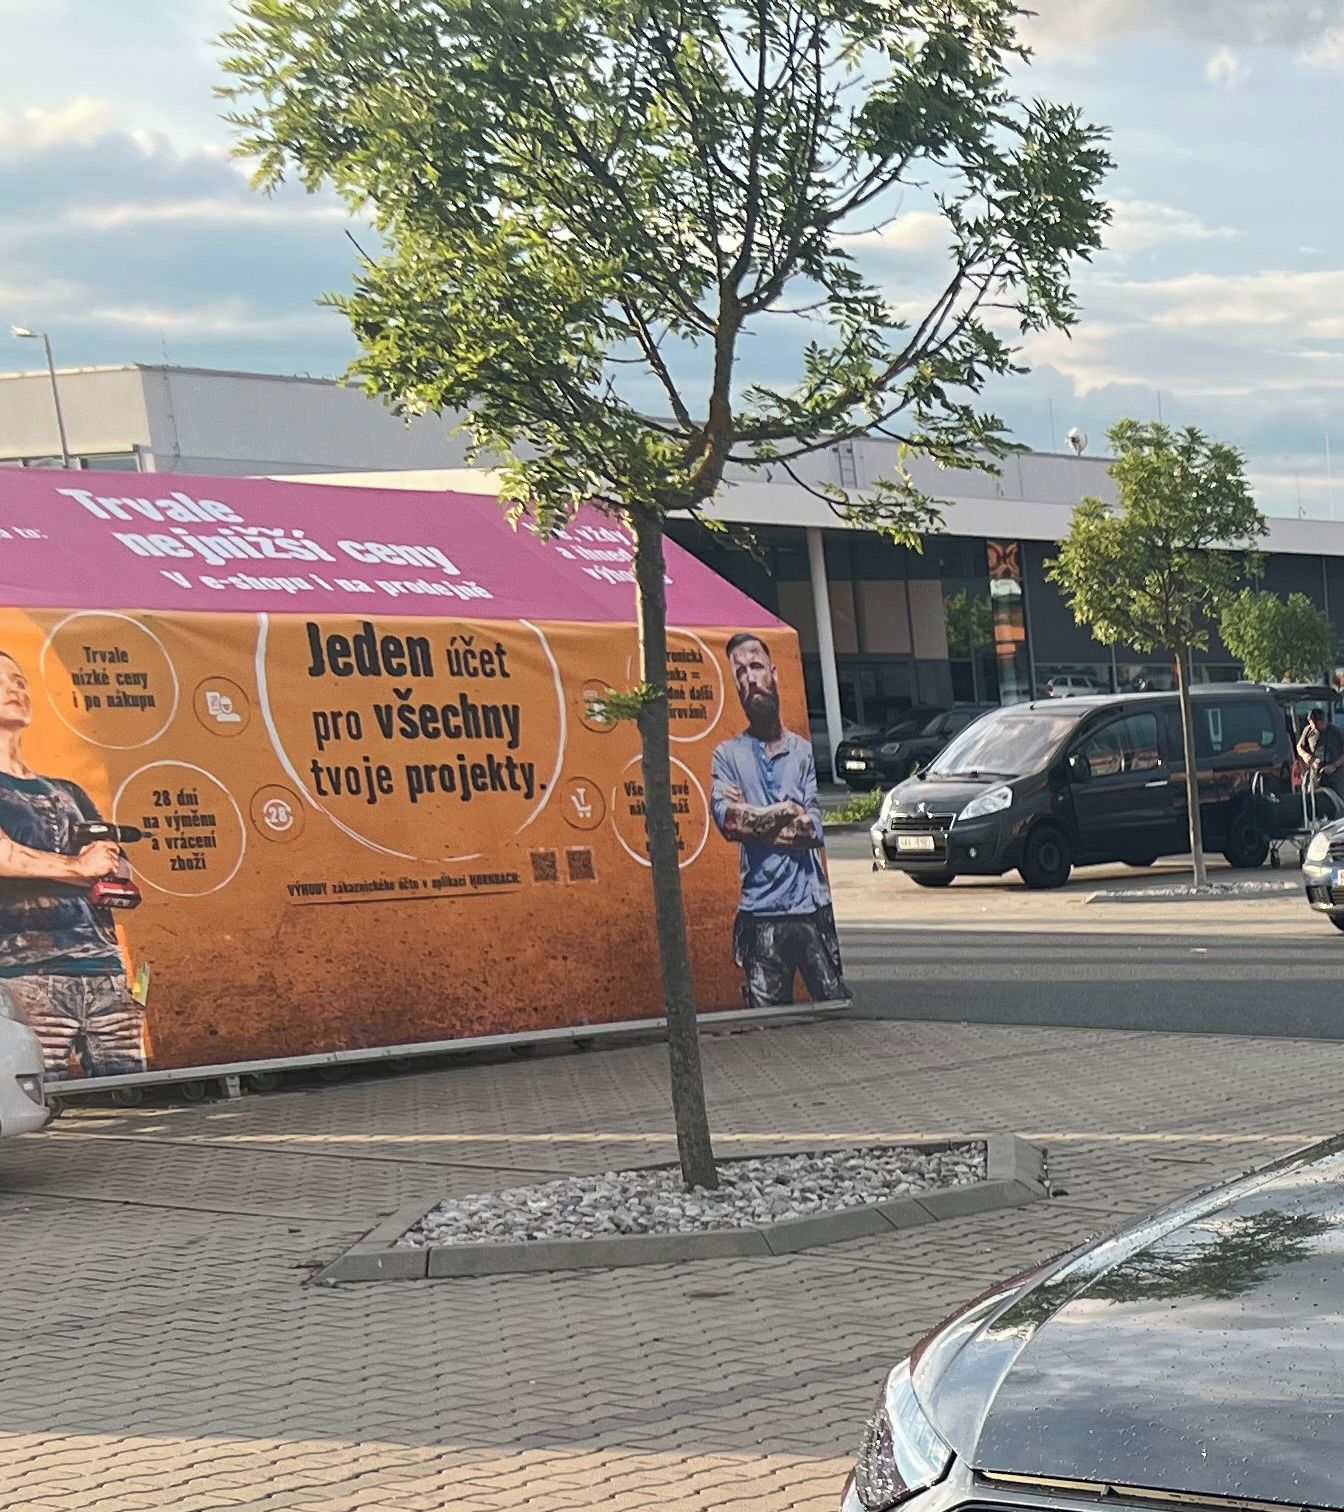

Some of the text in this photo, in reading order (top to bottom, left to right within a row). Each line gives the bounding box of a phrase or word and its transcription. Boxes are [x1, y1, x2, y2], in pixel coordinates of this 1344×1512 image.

[55, 487, 244, 523] Trvale
[112, 526, 461, 576] nejnižší ceny
[334, 578, 375, 593] na
[82, 646, 129, 664] Trvale
[306, 621, 511, 678] Jeden účet
[115, 671, 148, 690] ceny
[84, 694, 102, 712] po
[312, 687, 520, 751] pro všechny
[310, 753, 548, 805] tvoje projekty.
[152, 789, 172, 807] 28
[142, 809, 217, 831] na výměnu
[151, 831, 217, 851] a vrácení
